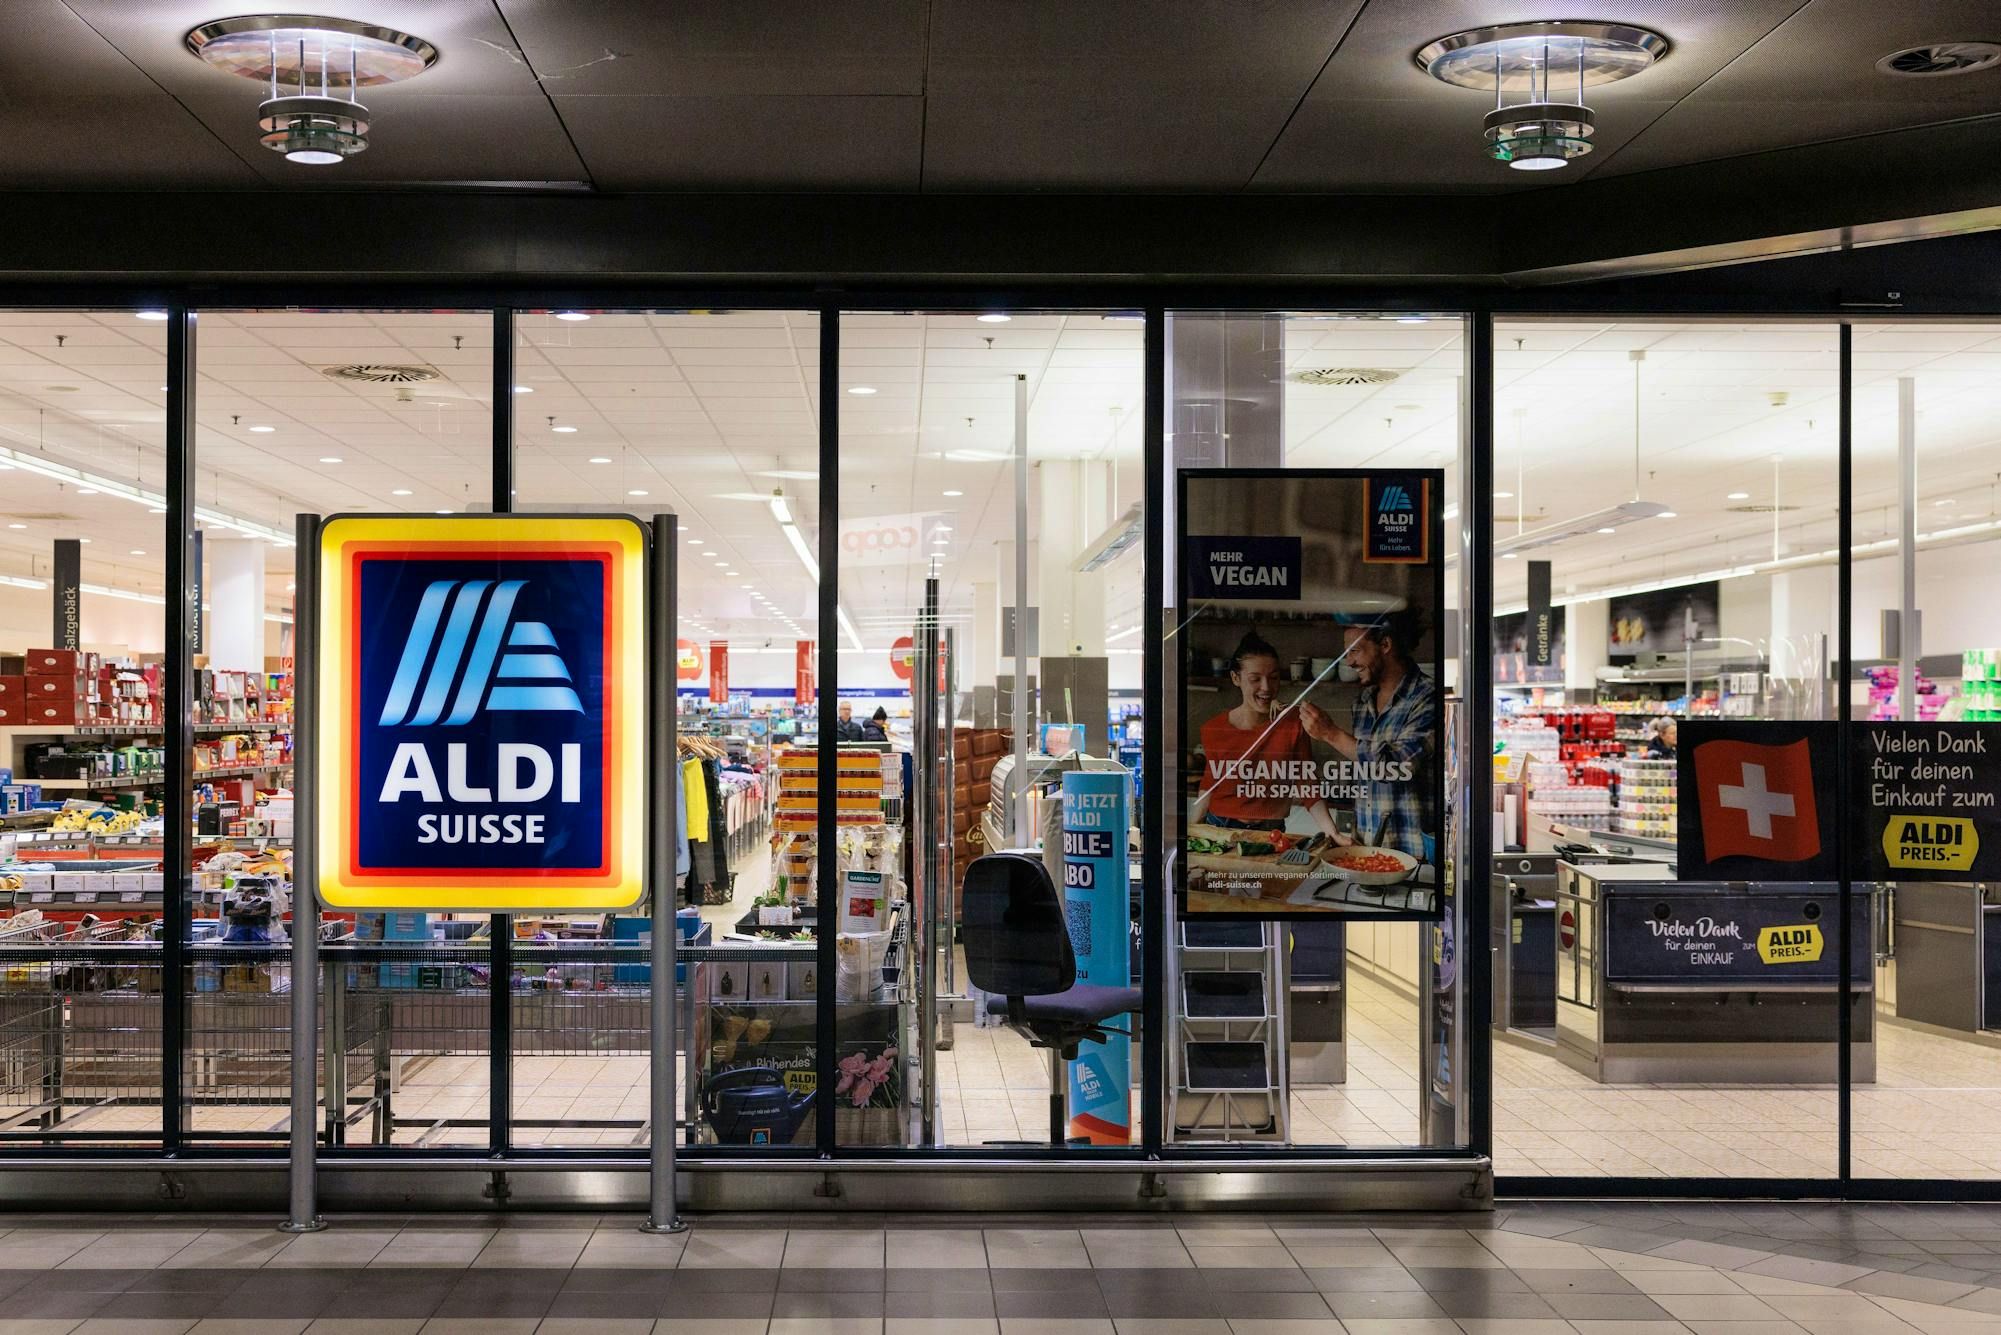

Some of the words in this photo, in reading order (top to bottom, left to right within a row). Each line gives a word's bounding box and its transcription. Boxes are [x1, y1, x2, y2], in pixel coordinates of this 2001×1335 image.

[1378, 513, 1414, 525] ALDI
[1210, 551, 1243, 562] MEHR
[1210, 566, 1287, 586] VEGAN
[64, 587, 78, 650] Salzgebäck
[1537, 614, 1548, 663] Getränke
[1872, 731, 1930, 753] Vielen
[1937, 731, 1986, 753] Dank
[378, 743, 581, 802] ALDI
[1209, 760, 1317, 780] VEGANER
[1323, 760, 1413, 781] GENUSS
[1872, 757, 1904, 780] für
[1911, 758, 1973, 780] deinen
[1236, 782, 1266, 798] FÜR
[1270, 782, 1369, 799] SPARFÜCHSE
[1872, 784, 1945, 807] Einkauf
[1952, 793, 1994, 807] zum
[1078, 794, 1118, 809] JETZT
[1071, 812, 1100, 826] ALDI
[417, 814, 546, 844] SUISSE
[1899, 823, 1963, 845] ALDI
[1063, 832, 1110, 855] BILE-
[1208, 871, 1227, 879] Mehr
[1274, 873, 1309, 881] veganen
[1208, 881, 1262, 889] aldi-suisse.ch
[1645, 920, 1694, 938] Vielen
[1696, 917, 1743, 940] Dank
[1769, 929, 1812, 947] ALDI
[1665, 939, 1681, 950] für
[1684, 939, 1716, 950] deinen
[1690, 952, 1735, 965] EINKAUF
[790, 1074, 816, 1084] ALDI
[1081, 1080, 1101, 1093] ALDI
